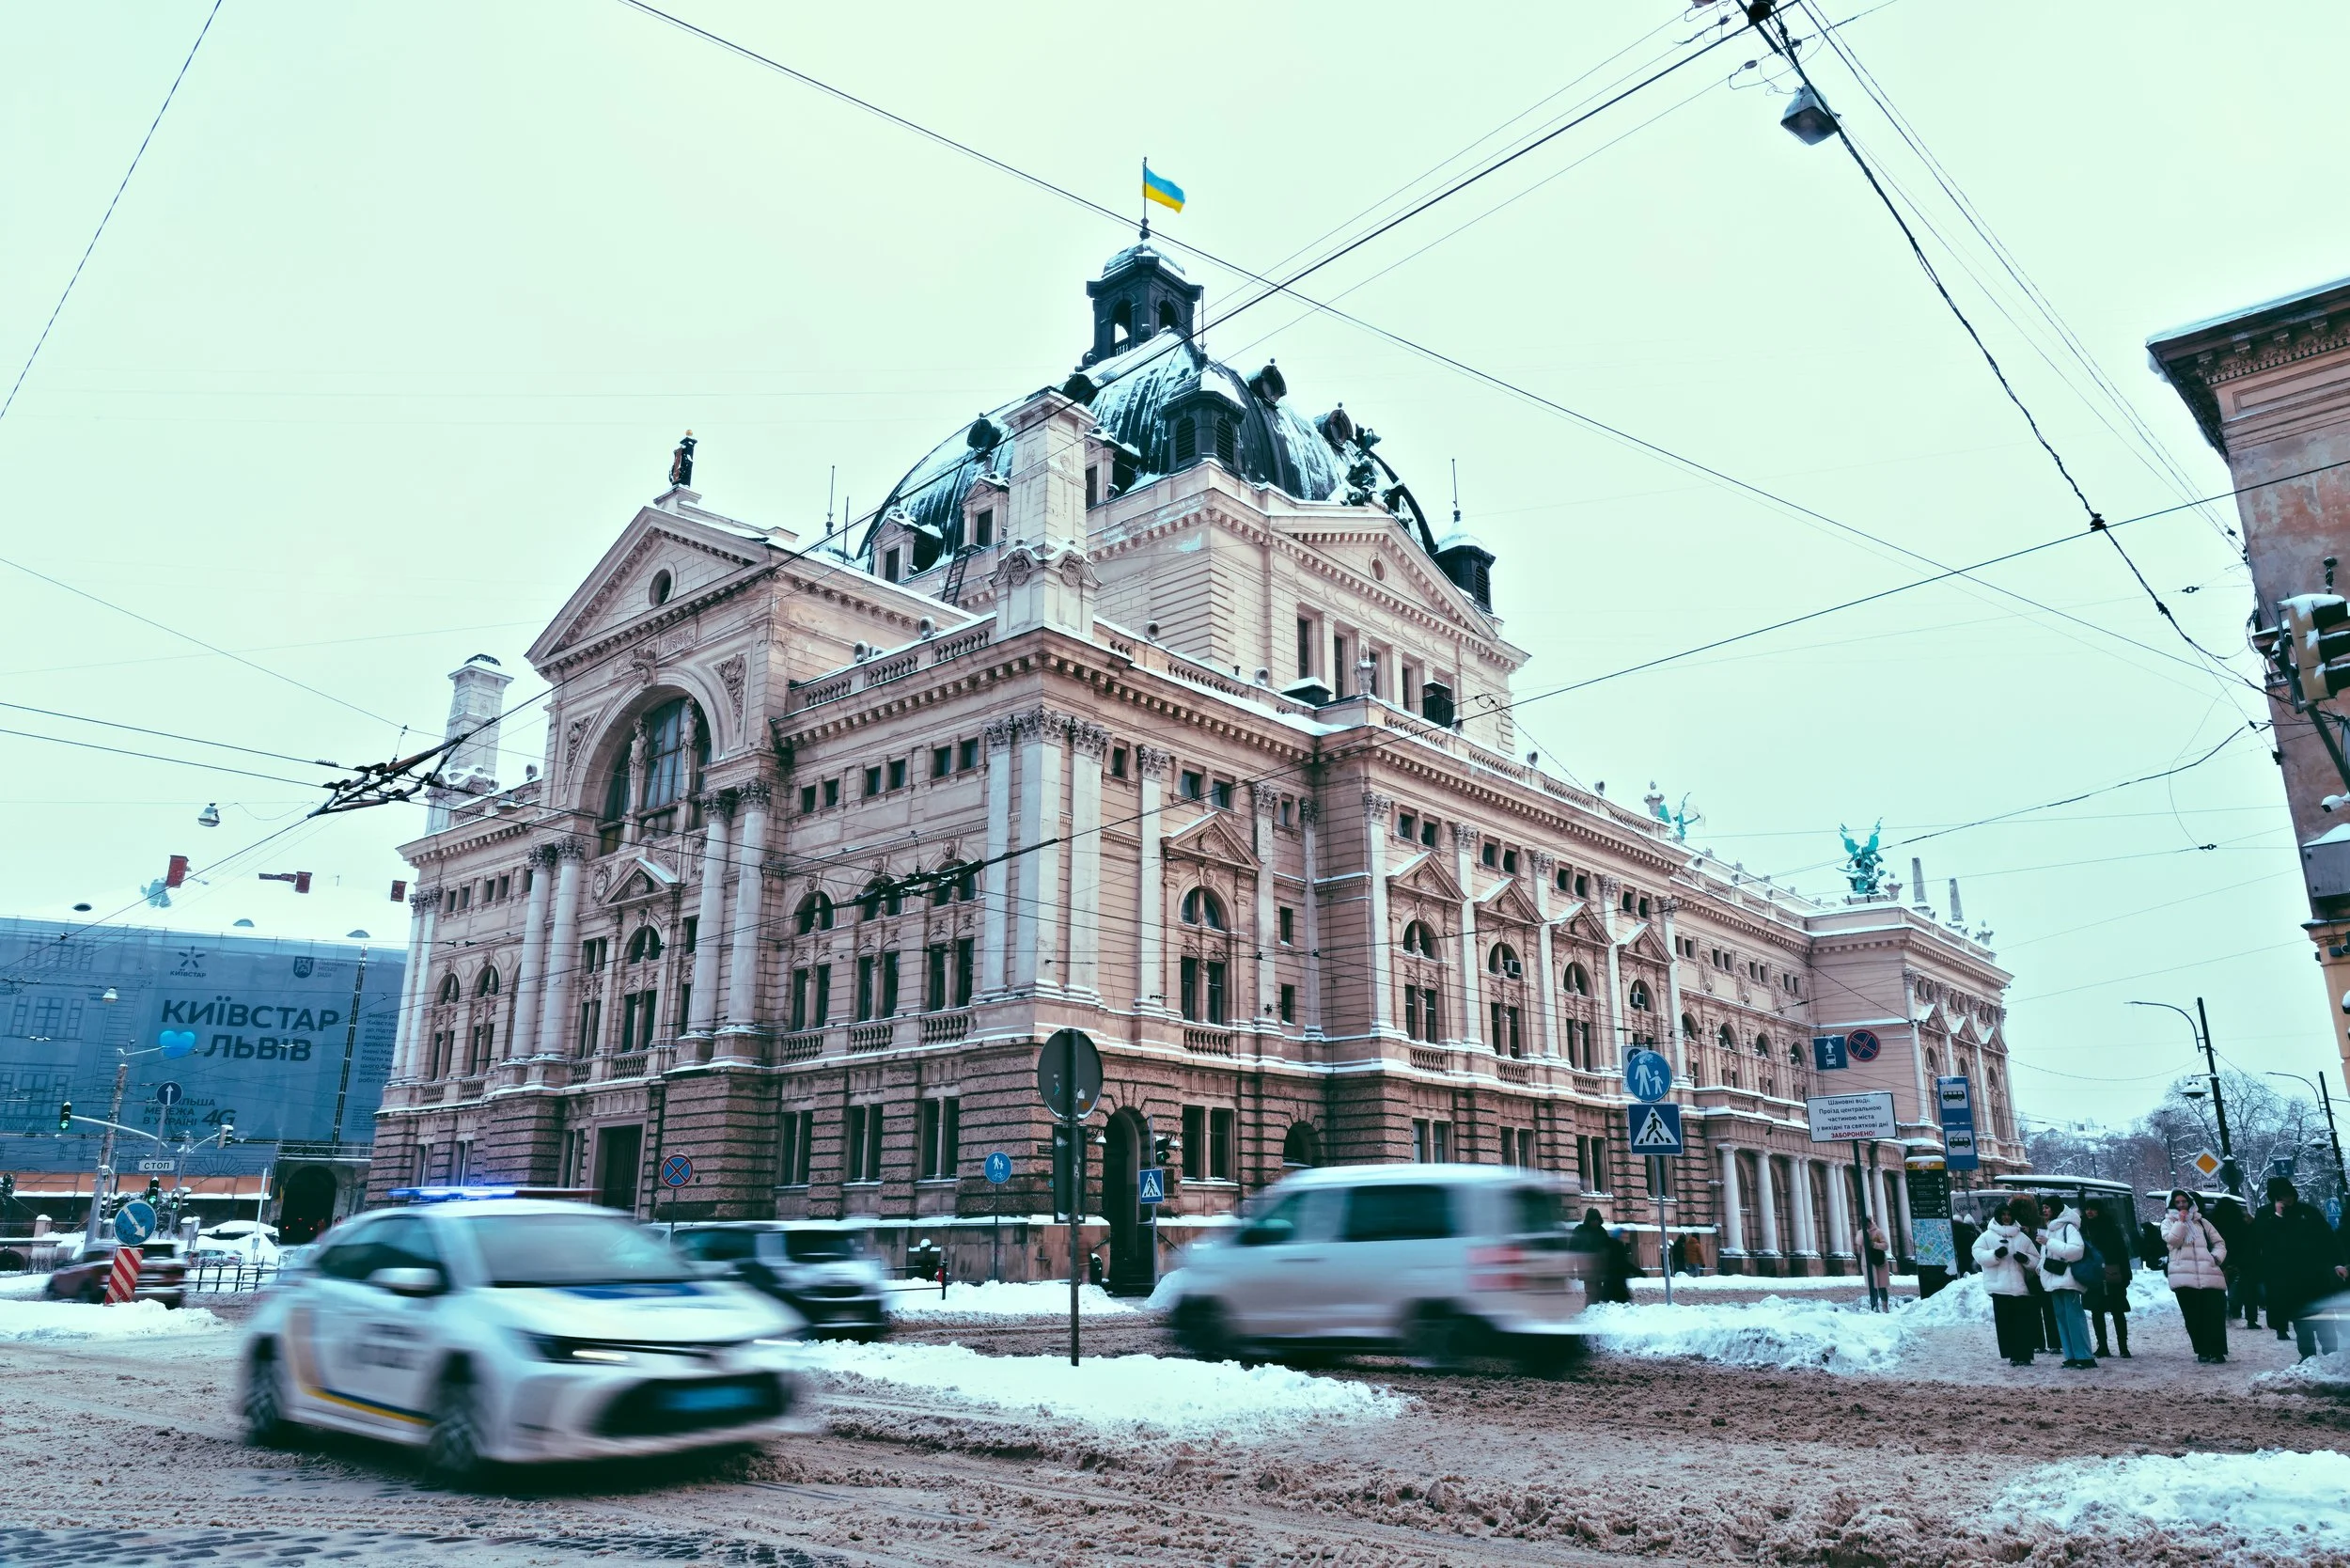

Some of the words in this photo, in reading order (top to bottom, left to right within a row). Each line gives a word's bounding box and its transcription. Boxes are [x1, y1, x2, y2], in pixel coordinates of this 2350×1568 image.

[170, 968, 207, 978] КИЇВСТАР
[161, 996, 339, 1032] КИЇВСТАР
[203, 1034, 312, 1062] ЛЬВІВ
[143, 1116, 150, 1125] В
[201, 1109, 237, 1127] 4G
